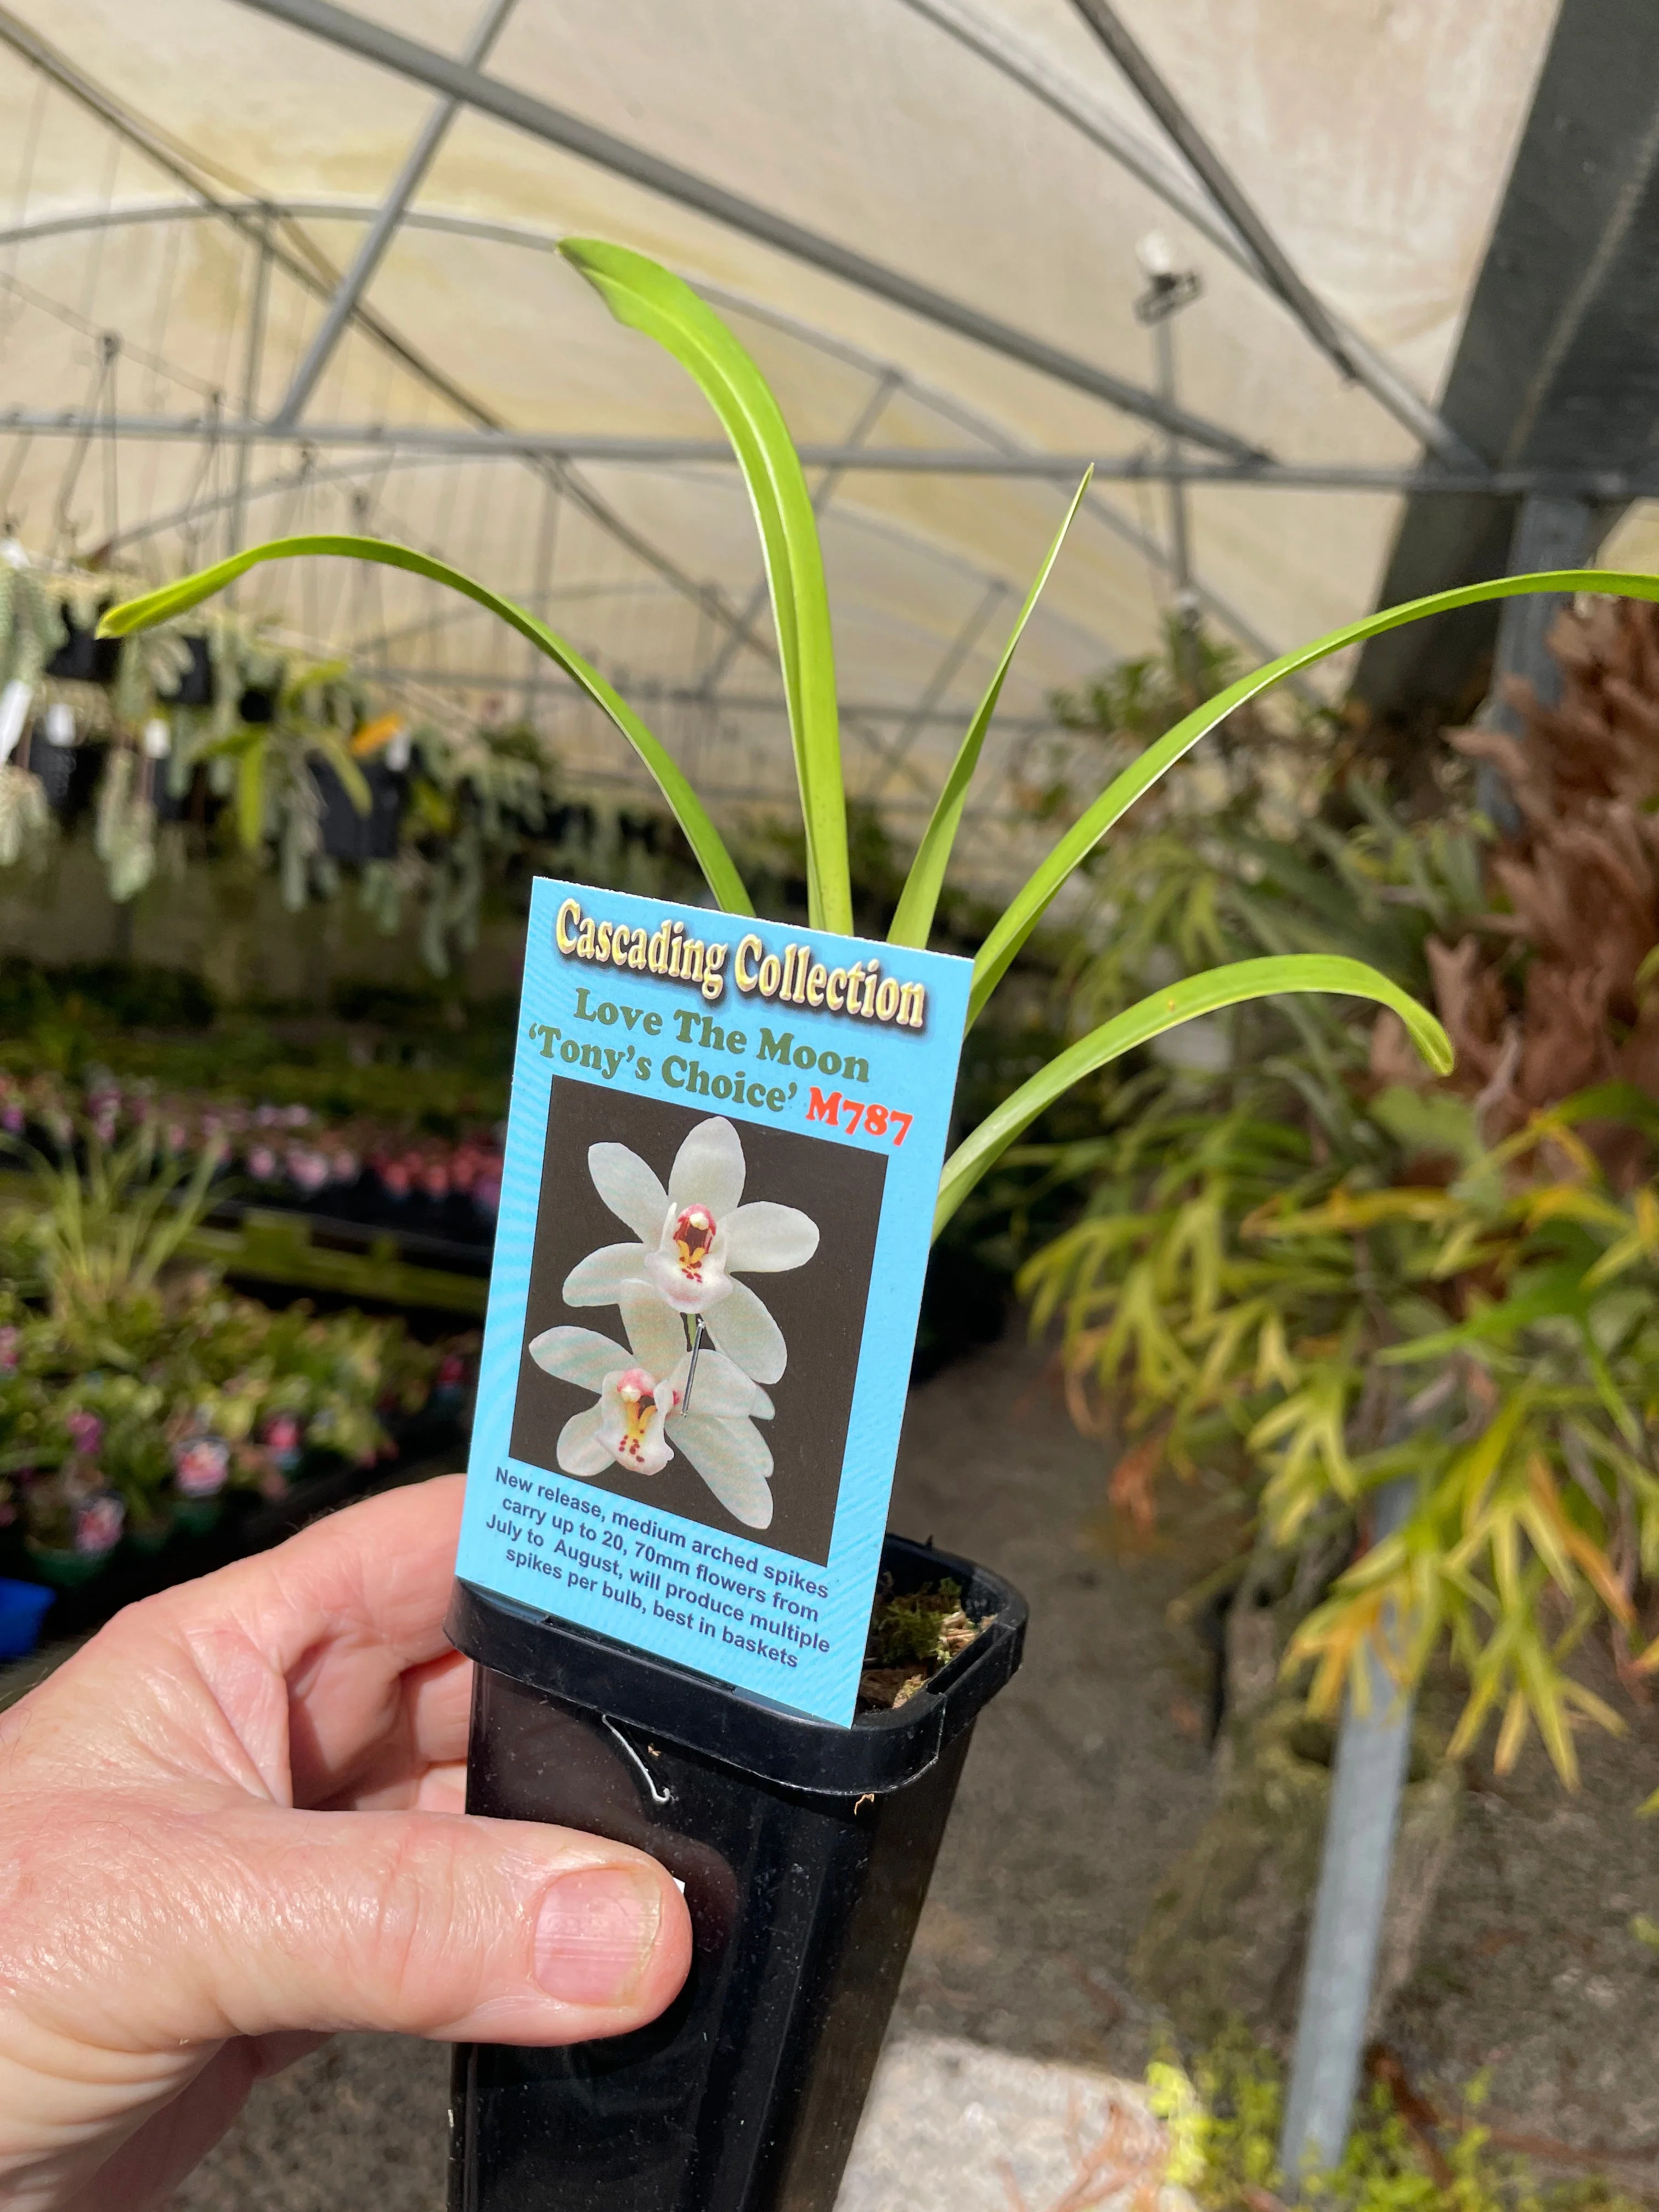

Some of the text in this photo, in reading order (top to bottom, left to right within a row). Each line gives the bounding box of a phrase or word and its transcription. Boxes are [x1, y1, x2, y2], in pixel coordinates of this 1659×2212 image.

[556, 898, 926, 1028] Cascading Collection
[574, 988, 869, 1082] Love The Moon
[806, 1086, 913, 1147] M787
[486, 1514, 830, 1652] July to August, will produce multiple
[496, 1466, 829, 1599] New release, medium arched spikes
[503, 1497, 819, 1622] carry up to 20, 70mm flowers from
[506, 1548, 798, 1668] spikes per bulb, best in baskets
